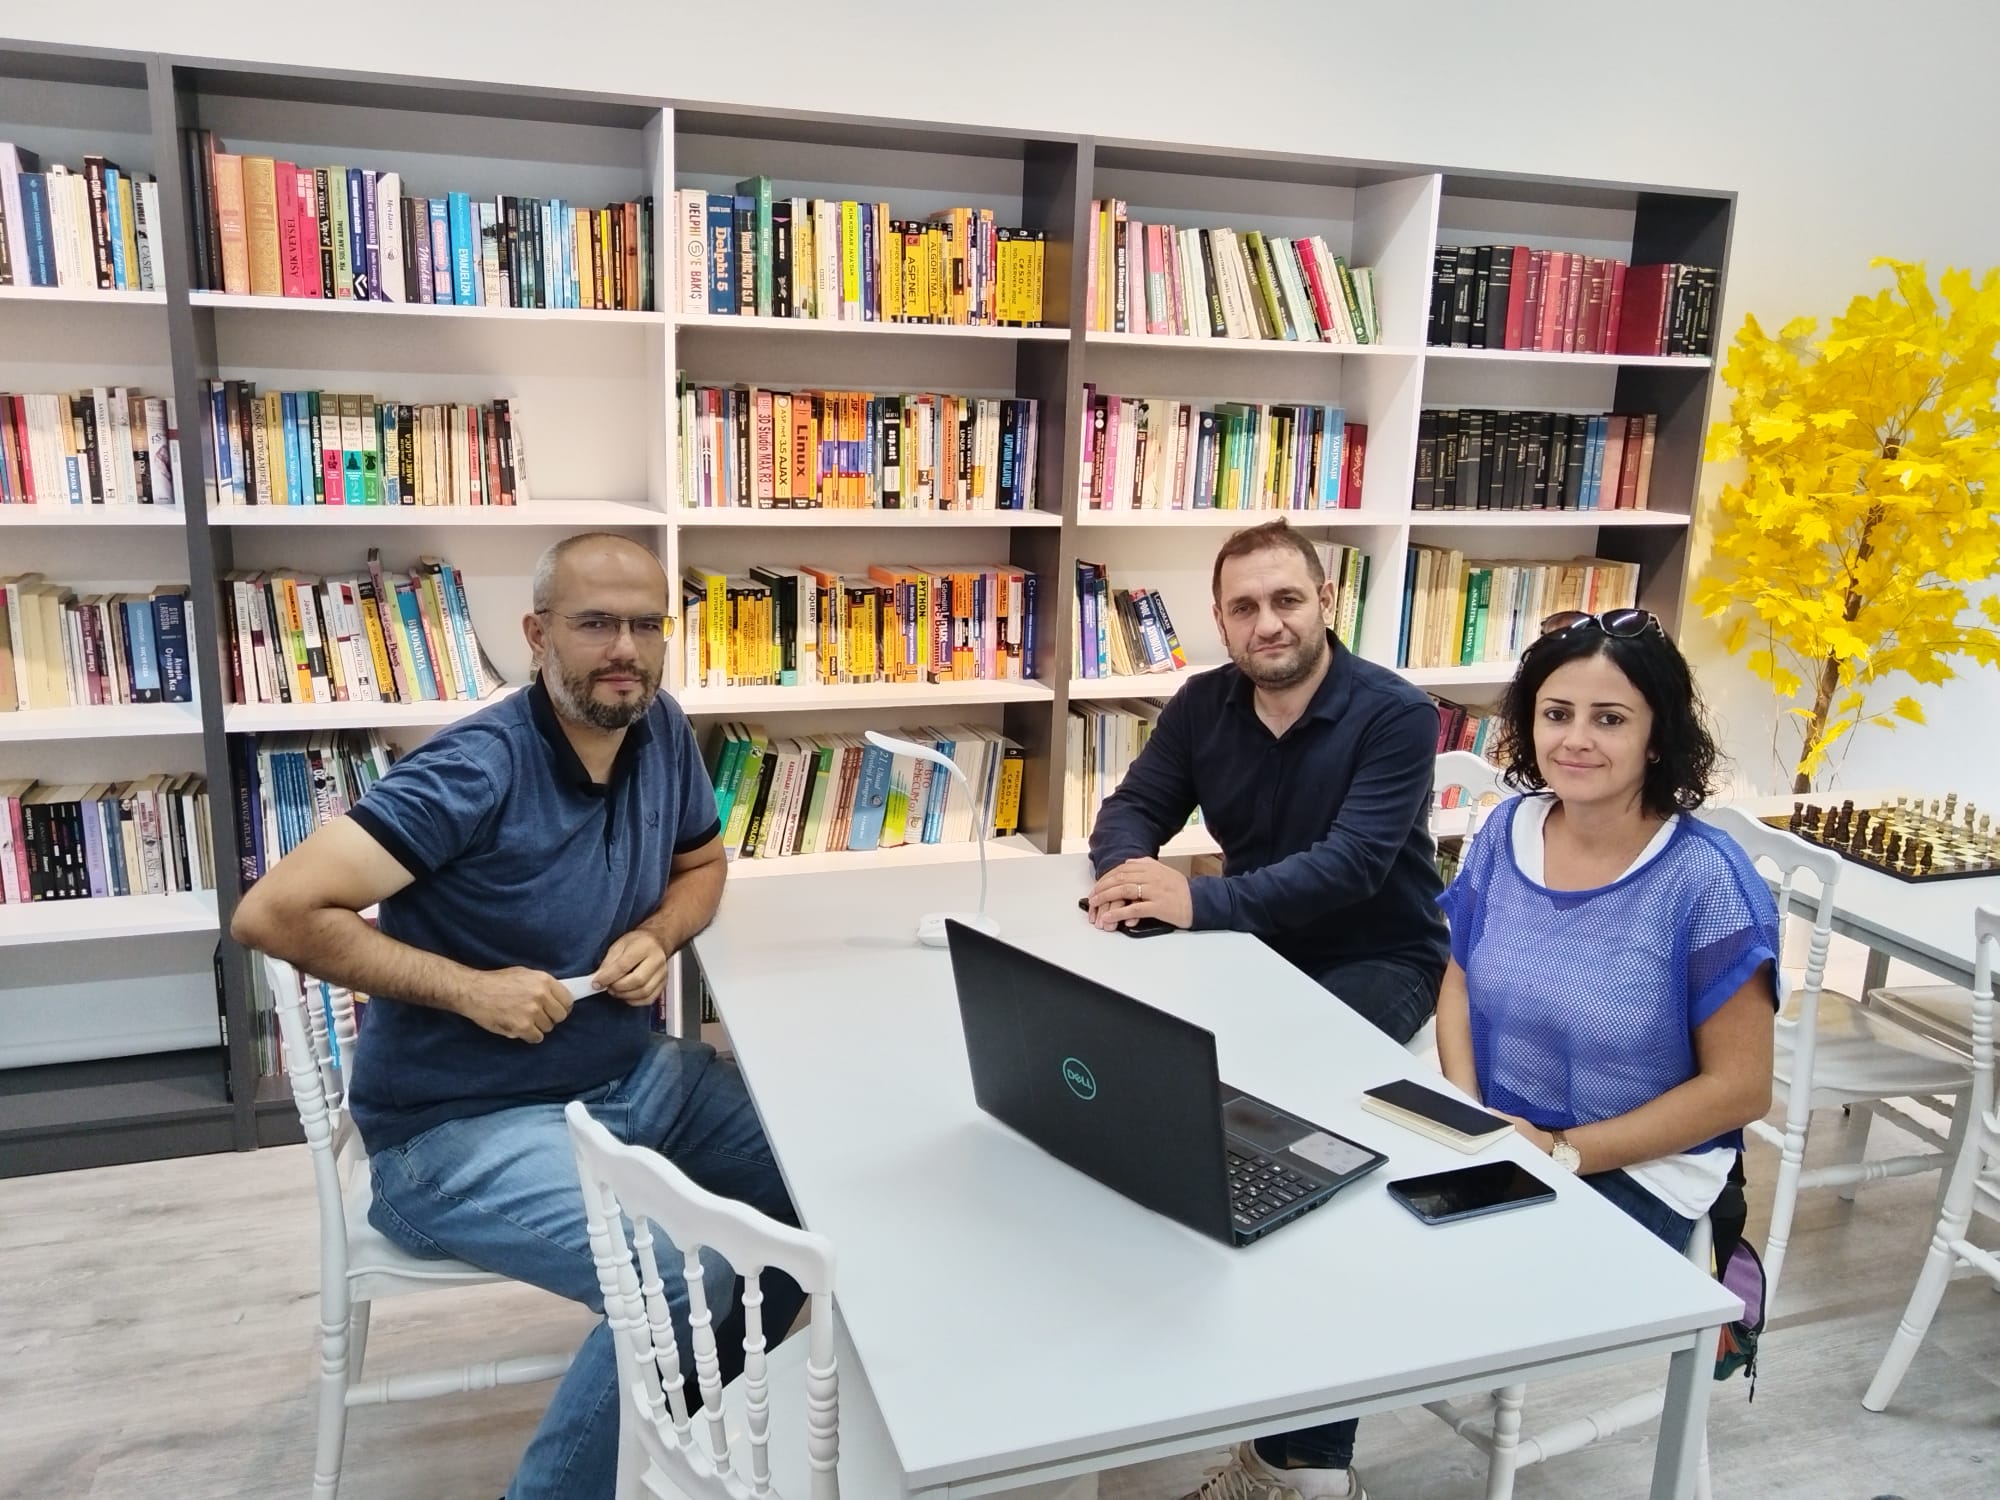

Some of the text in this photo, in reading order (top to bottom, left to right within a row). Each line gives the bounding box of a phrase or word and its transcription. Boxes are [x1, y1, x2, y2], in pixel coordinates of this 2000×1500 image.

[91, 180, 102, 198] CUMA
[287, 218, 296, 252] VEYSEL
[689, 202, 702, 299] DELPHI BAKIŞ
[714, 226, 727, 278] Delphi
[742, 232, 751, 252] Visual
[141, 245, 152, 280] CASEY
[459, 248, 470, 296] EVANJELİZM
[742, 253, 752, 273] BASIC
[718, 281, 728, 291] 5
[743, 274, 752, 288] PRO
[743, 290, 753, 302] 5.0
[908, 257, 916, 304] ASP.NET
[313, 439, 322, 477] gözyaşları
[759, 414, 771, 483] 3D Studio MAX R3
[796, 425, 808, 477] Linux
[1002, 434, 1013, 488] KAPTANIN KILAVUZU
[1330, 435, 1340, 479] BİYOKİMYA
[405, 459, 413, 484] MABET
[779, 456, 787, 485] AJAX
[159, 603, 170, 630] LARSSON
[169, 607, 179, 625] STIEG
[303, 599, 312, 615] Java
[1154, 594, 1171, 629] LONGMAN
[1464, 588, 1479, 653] ANALİTİK KİMYA
[407, 619, 427, 670] BİYOKİMYA
[940, 612, 950, 642] Linux
[1146, 625, 1165, 661] DICTIONARY
[88, 655, 96, 672] Orhan
[353, 639, 362, 657] Pratik
[164, 648, 177, 691] Oynayan Kız
[862, 750, 877, 808] Biyoloji Kongresi
[875, 752, 889, 790] 21. Ulusal
[923, 769, 932, 788] BTO
[314, 759, 332, 825] LMANAK 2016
[25, 808, 36, 840] stephen king
[241, 787, 252, 848] KILAVUZ ATLASI
[1067, 1069, 1093, 1089] DELL
